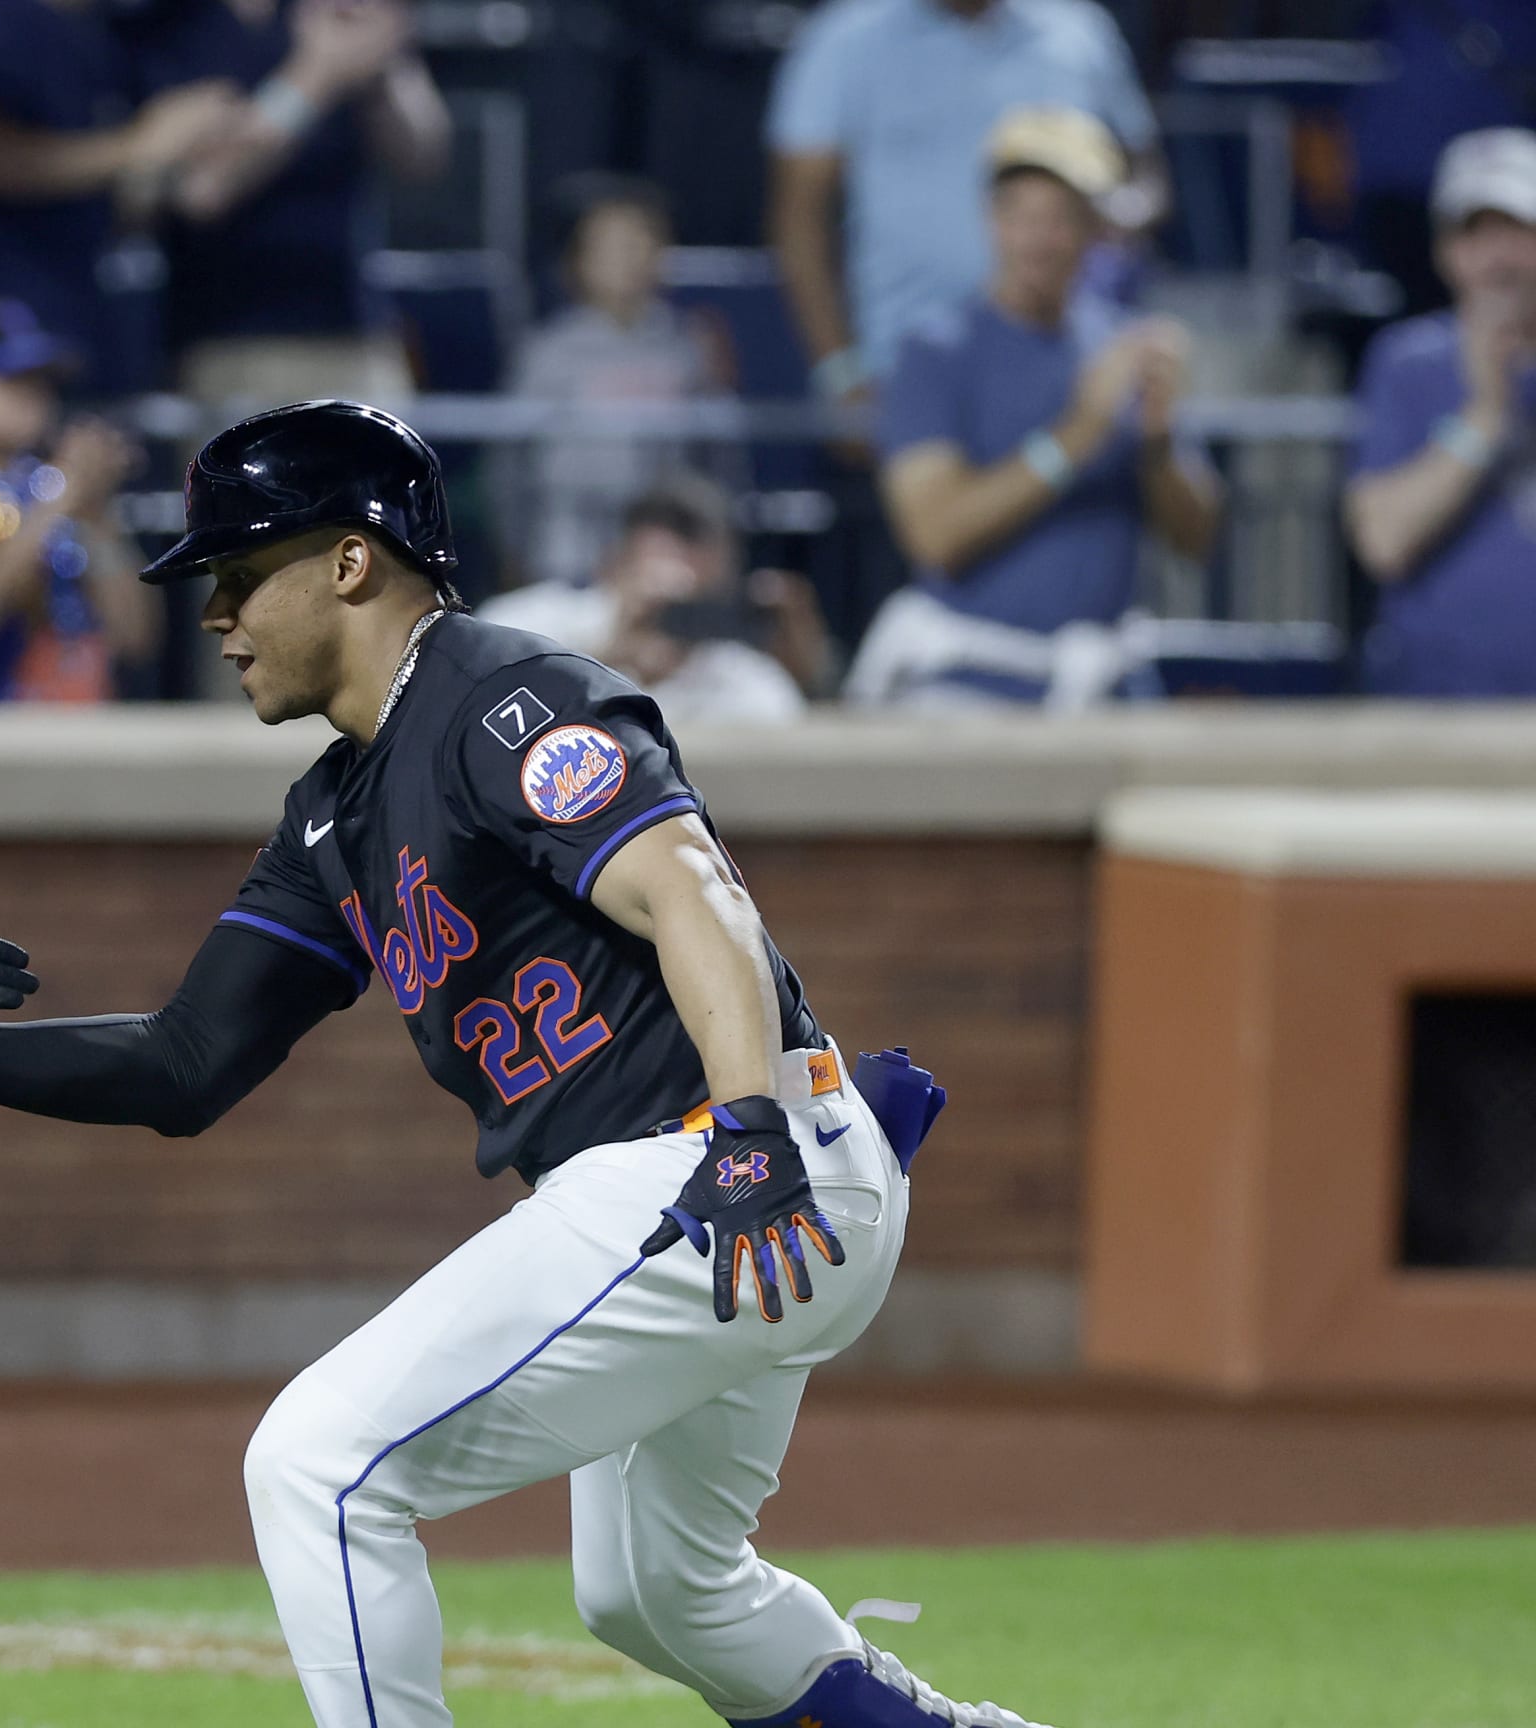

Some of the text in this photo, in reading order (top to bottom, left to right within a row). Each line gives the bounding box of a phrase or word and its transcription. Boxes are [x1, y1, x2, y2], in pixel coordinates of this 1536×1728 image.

[499, 701, 526, 735] 7
[553, 746, 608, 811] Mets
[453, 956, 613, 1106] 22
